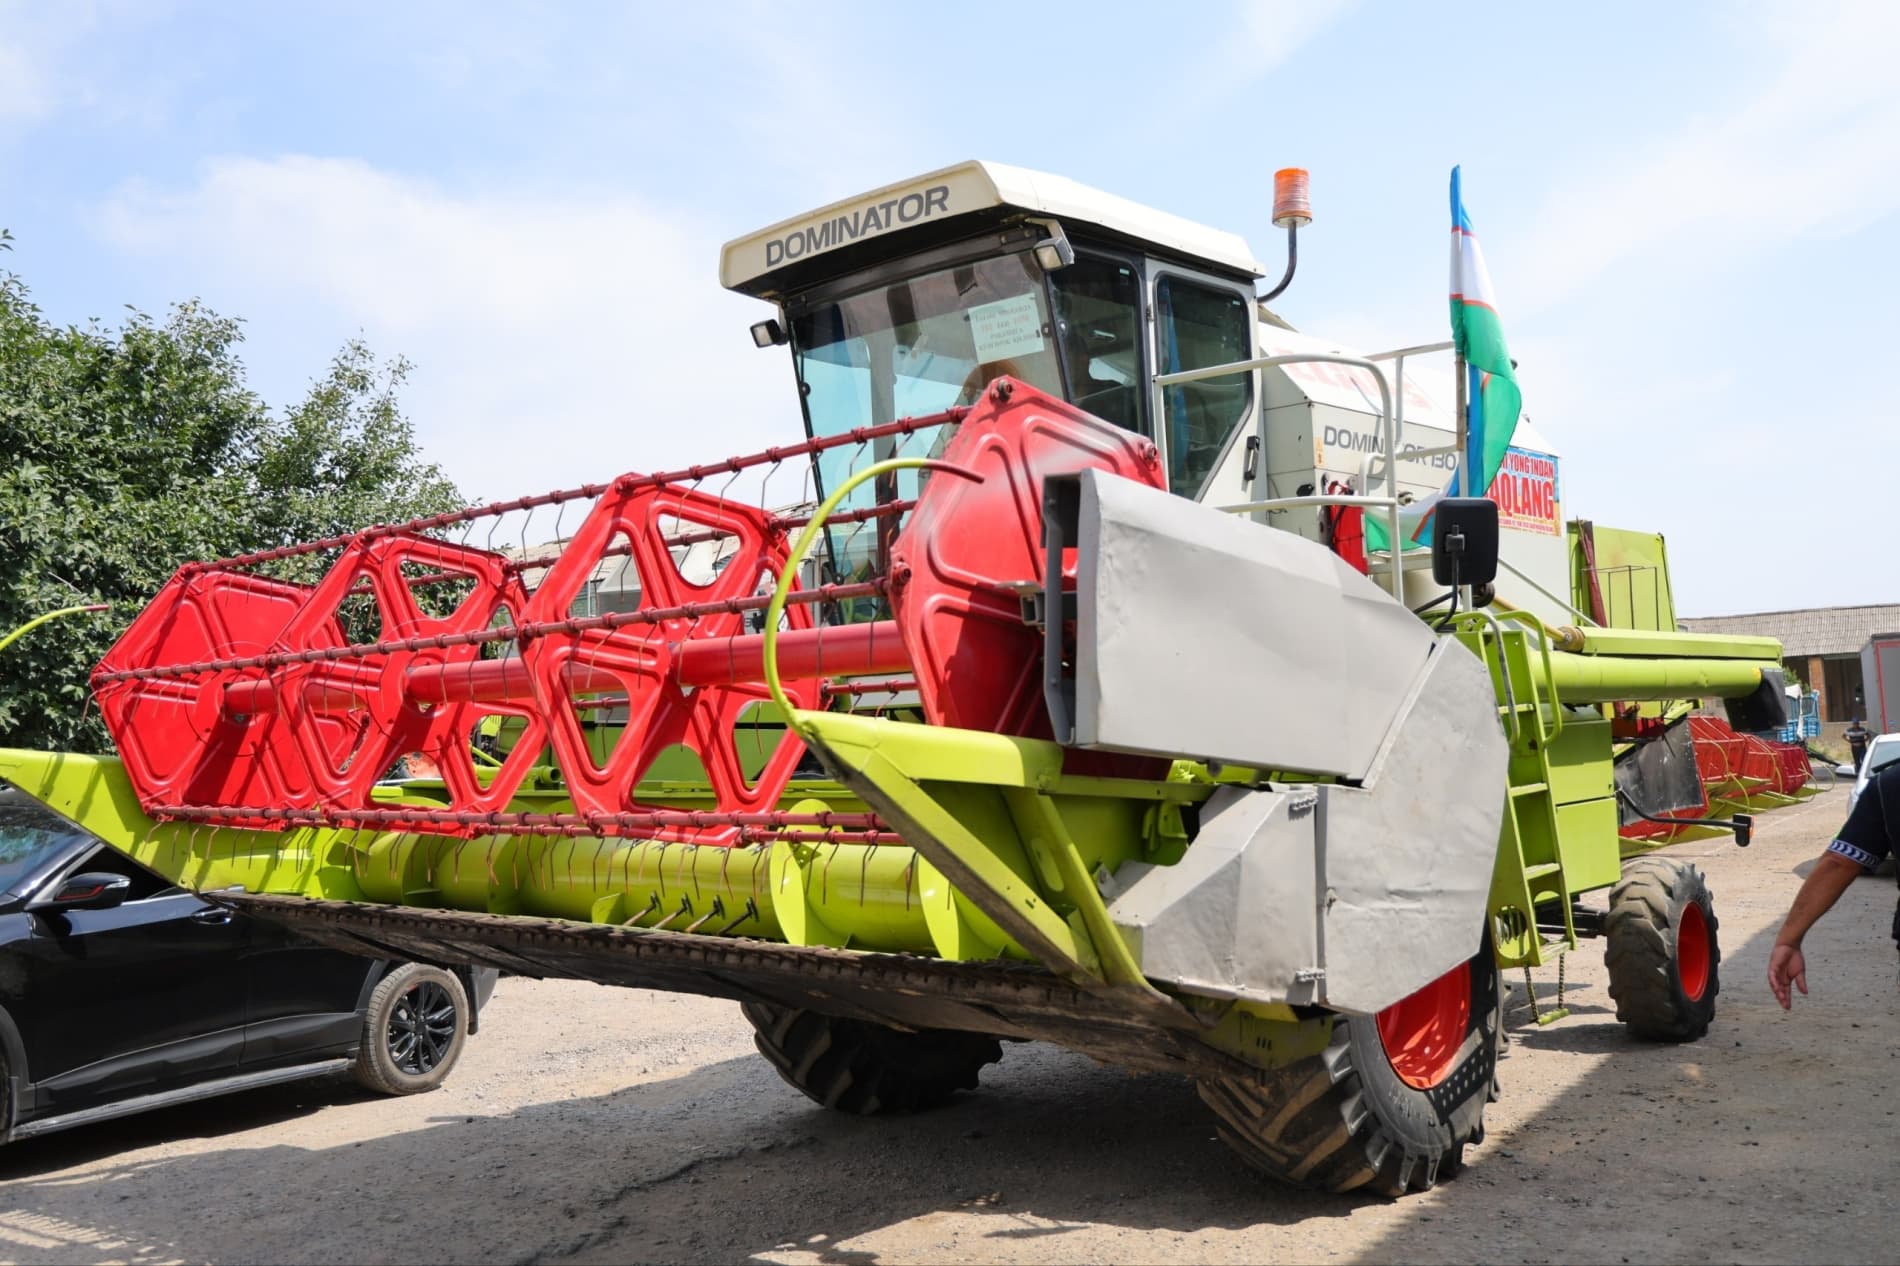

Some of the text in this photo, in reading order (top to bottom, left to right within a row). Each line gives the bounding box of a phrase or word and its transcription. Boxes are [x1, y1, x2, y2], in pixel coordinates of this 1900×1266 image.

[766, 185, 949, 268] DOMINATOR
[1324, 425, 1426, 466] DOMINOR
[1485, 473, 1554, 521] AQLANG
